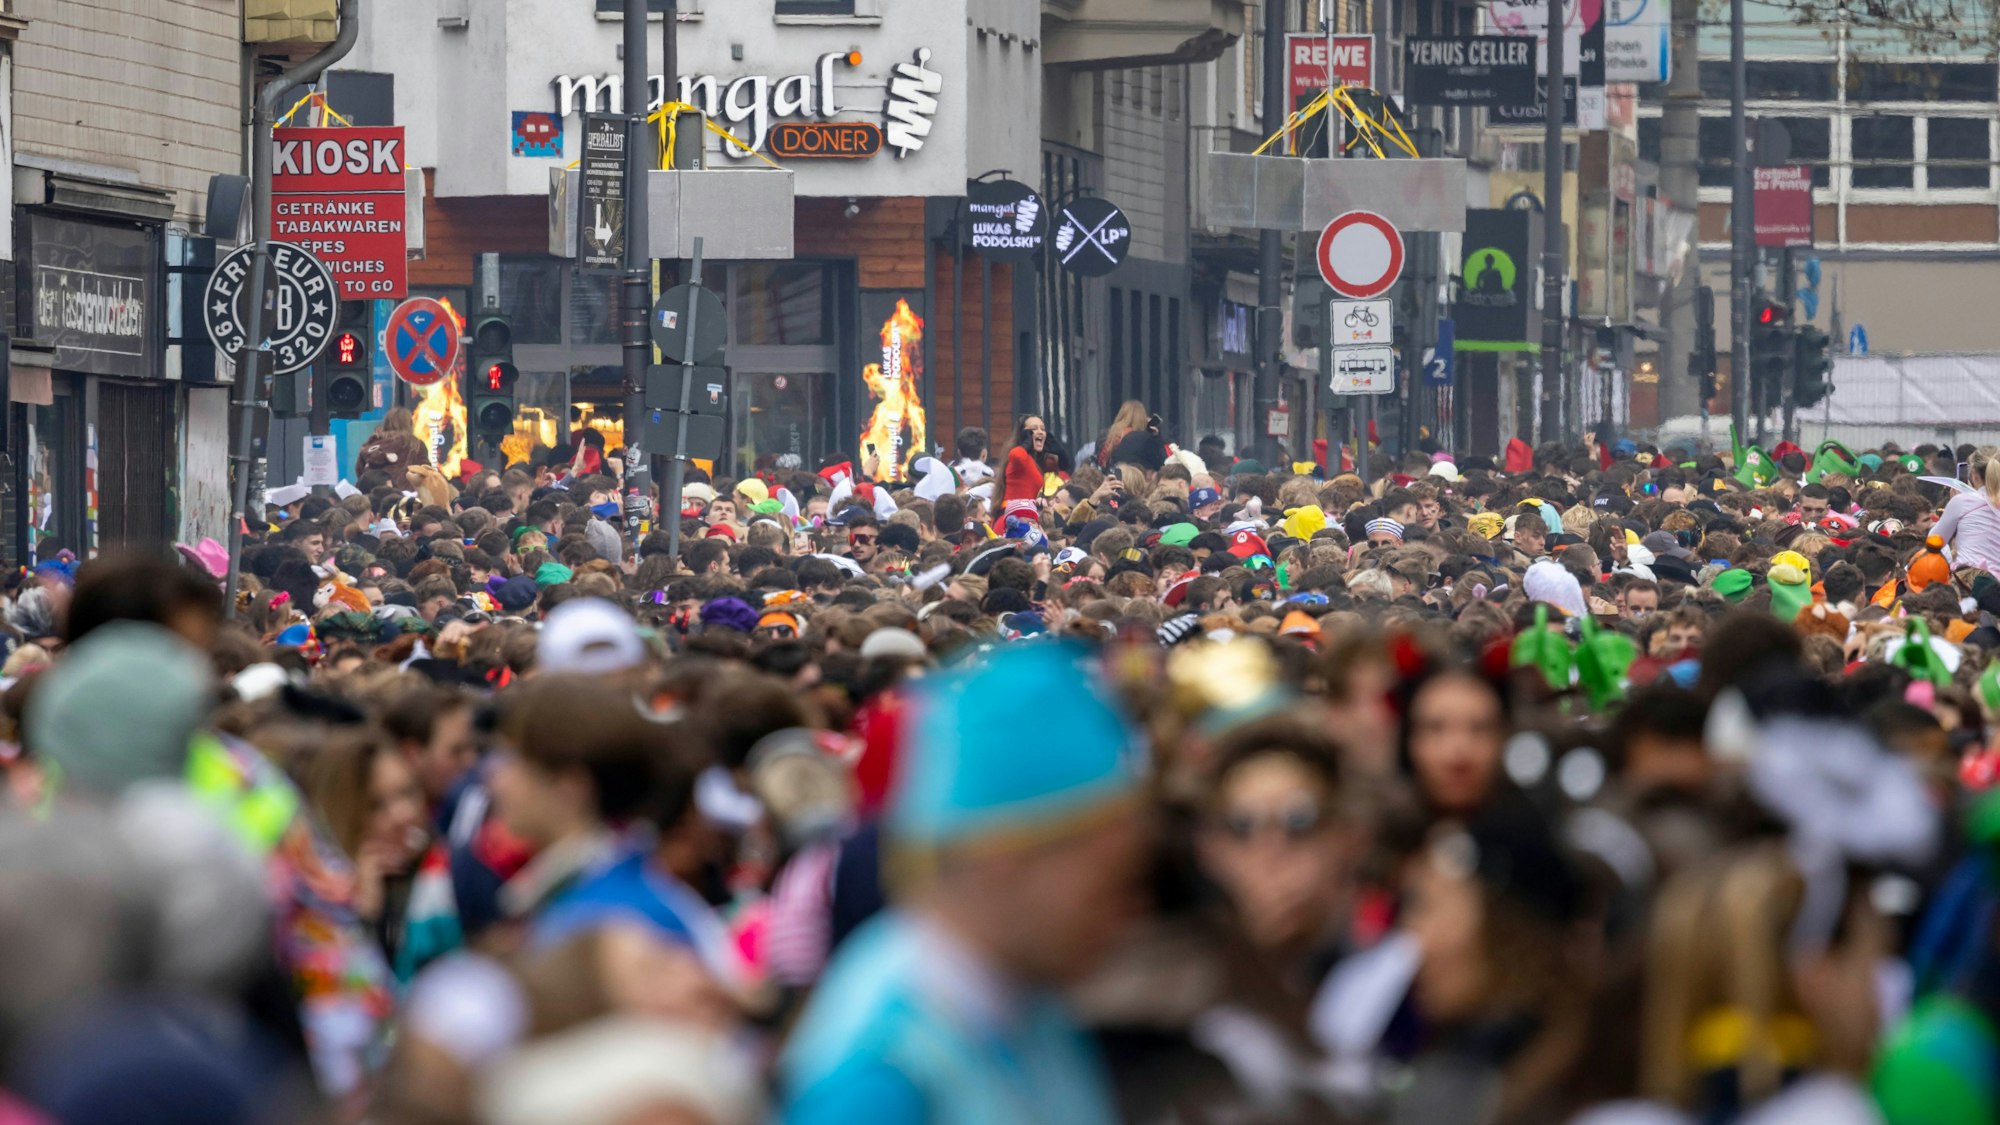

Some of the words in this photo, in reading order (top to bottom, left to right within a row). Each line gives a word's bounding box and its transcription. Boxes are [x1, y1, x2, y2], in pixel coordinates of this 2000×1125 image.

[1295, 45, 1366, 67] REWE
[1468, 41, 1528, 65] CELLER
[783, 126, 869, 152] DÖNER
[272, 139, 400, 175] KIOSK
[276, 200, 375, 215] GETRÄNKE
[969, 202, 1015, 219] mangal
[276, 220, 401, 233] TABAKWAREN
[972, 223, 1012, 235] LUKAS
[214, 248, 325, 297] FRIEUR
[324, 261, 385, 273] WICHES
[344, 281, 366, 292] TO
[371, 280, 394, 292] GO
[882, 346, 892, 378] LUKAS
